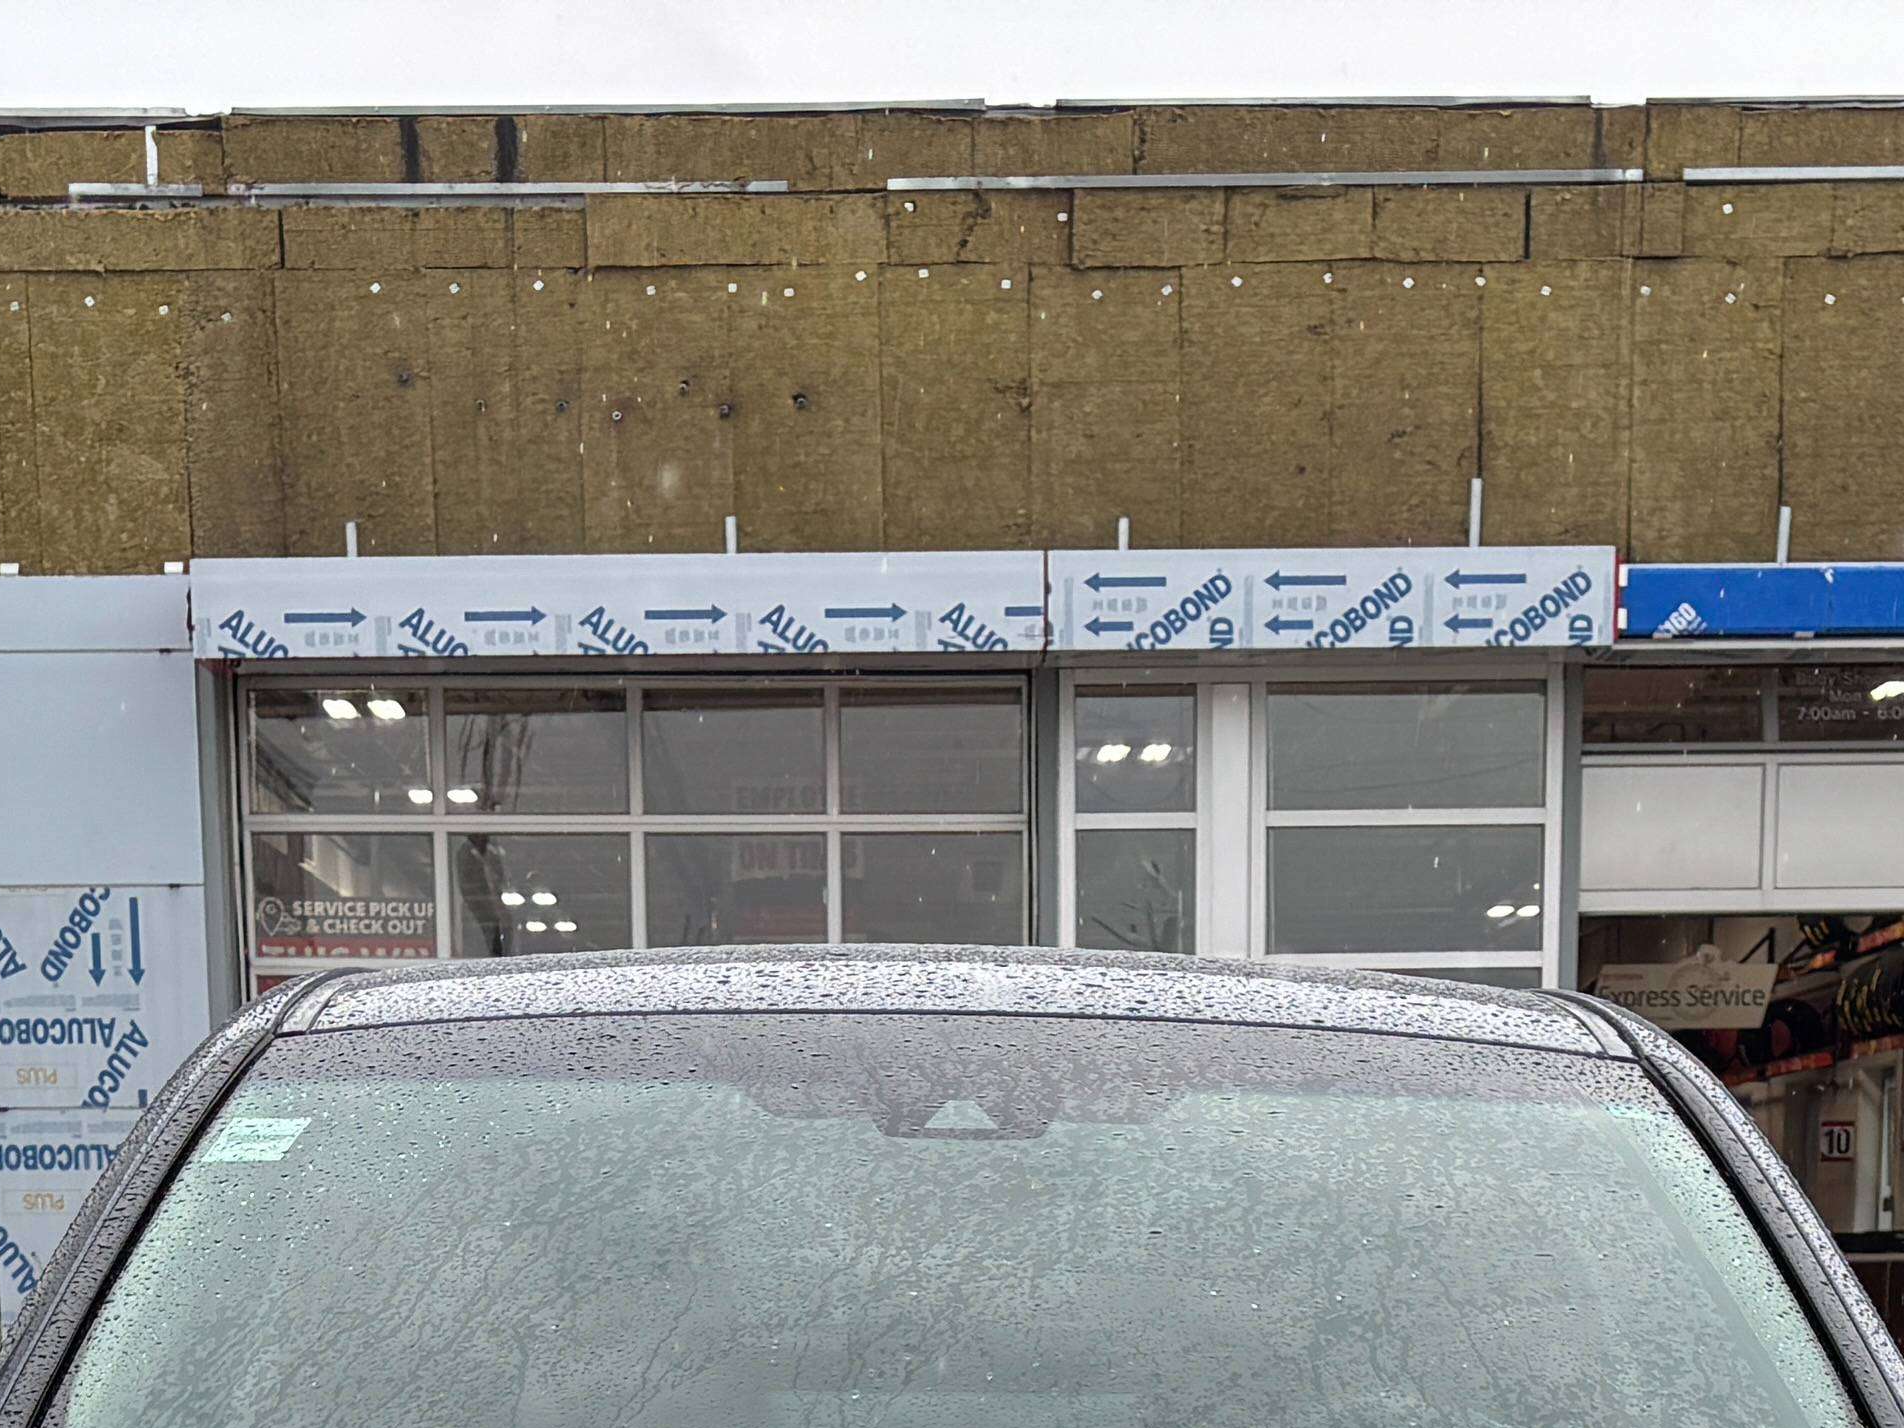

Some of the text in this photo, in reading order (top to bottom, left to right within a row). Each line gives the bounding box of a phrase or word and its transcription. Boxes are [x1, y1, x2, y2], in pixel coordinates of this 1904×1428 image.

[1126, 573, 1233, 650] COBOND
[1306, 572, 1413, 649] COBOND
[1485, 571, 1592, 648] COBOND
[292, 901, 369, 918] SERVICE
[370, 902, 413, 917] PICK
[306, 919, 427, 934] & CHECK OUT
[1598, 984, 1766, 1008] Express Service
[16, 1068, 58, 1085] PLUS
[80, 1019, 149, 1112] ALUCO
[1825, 1128, 1851, 1155] 10
[22, 1193, 65, 1211] PLUS
